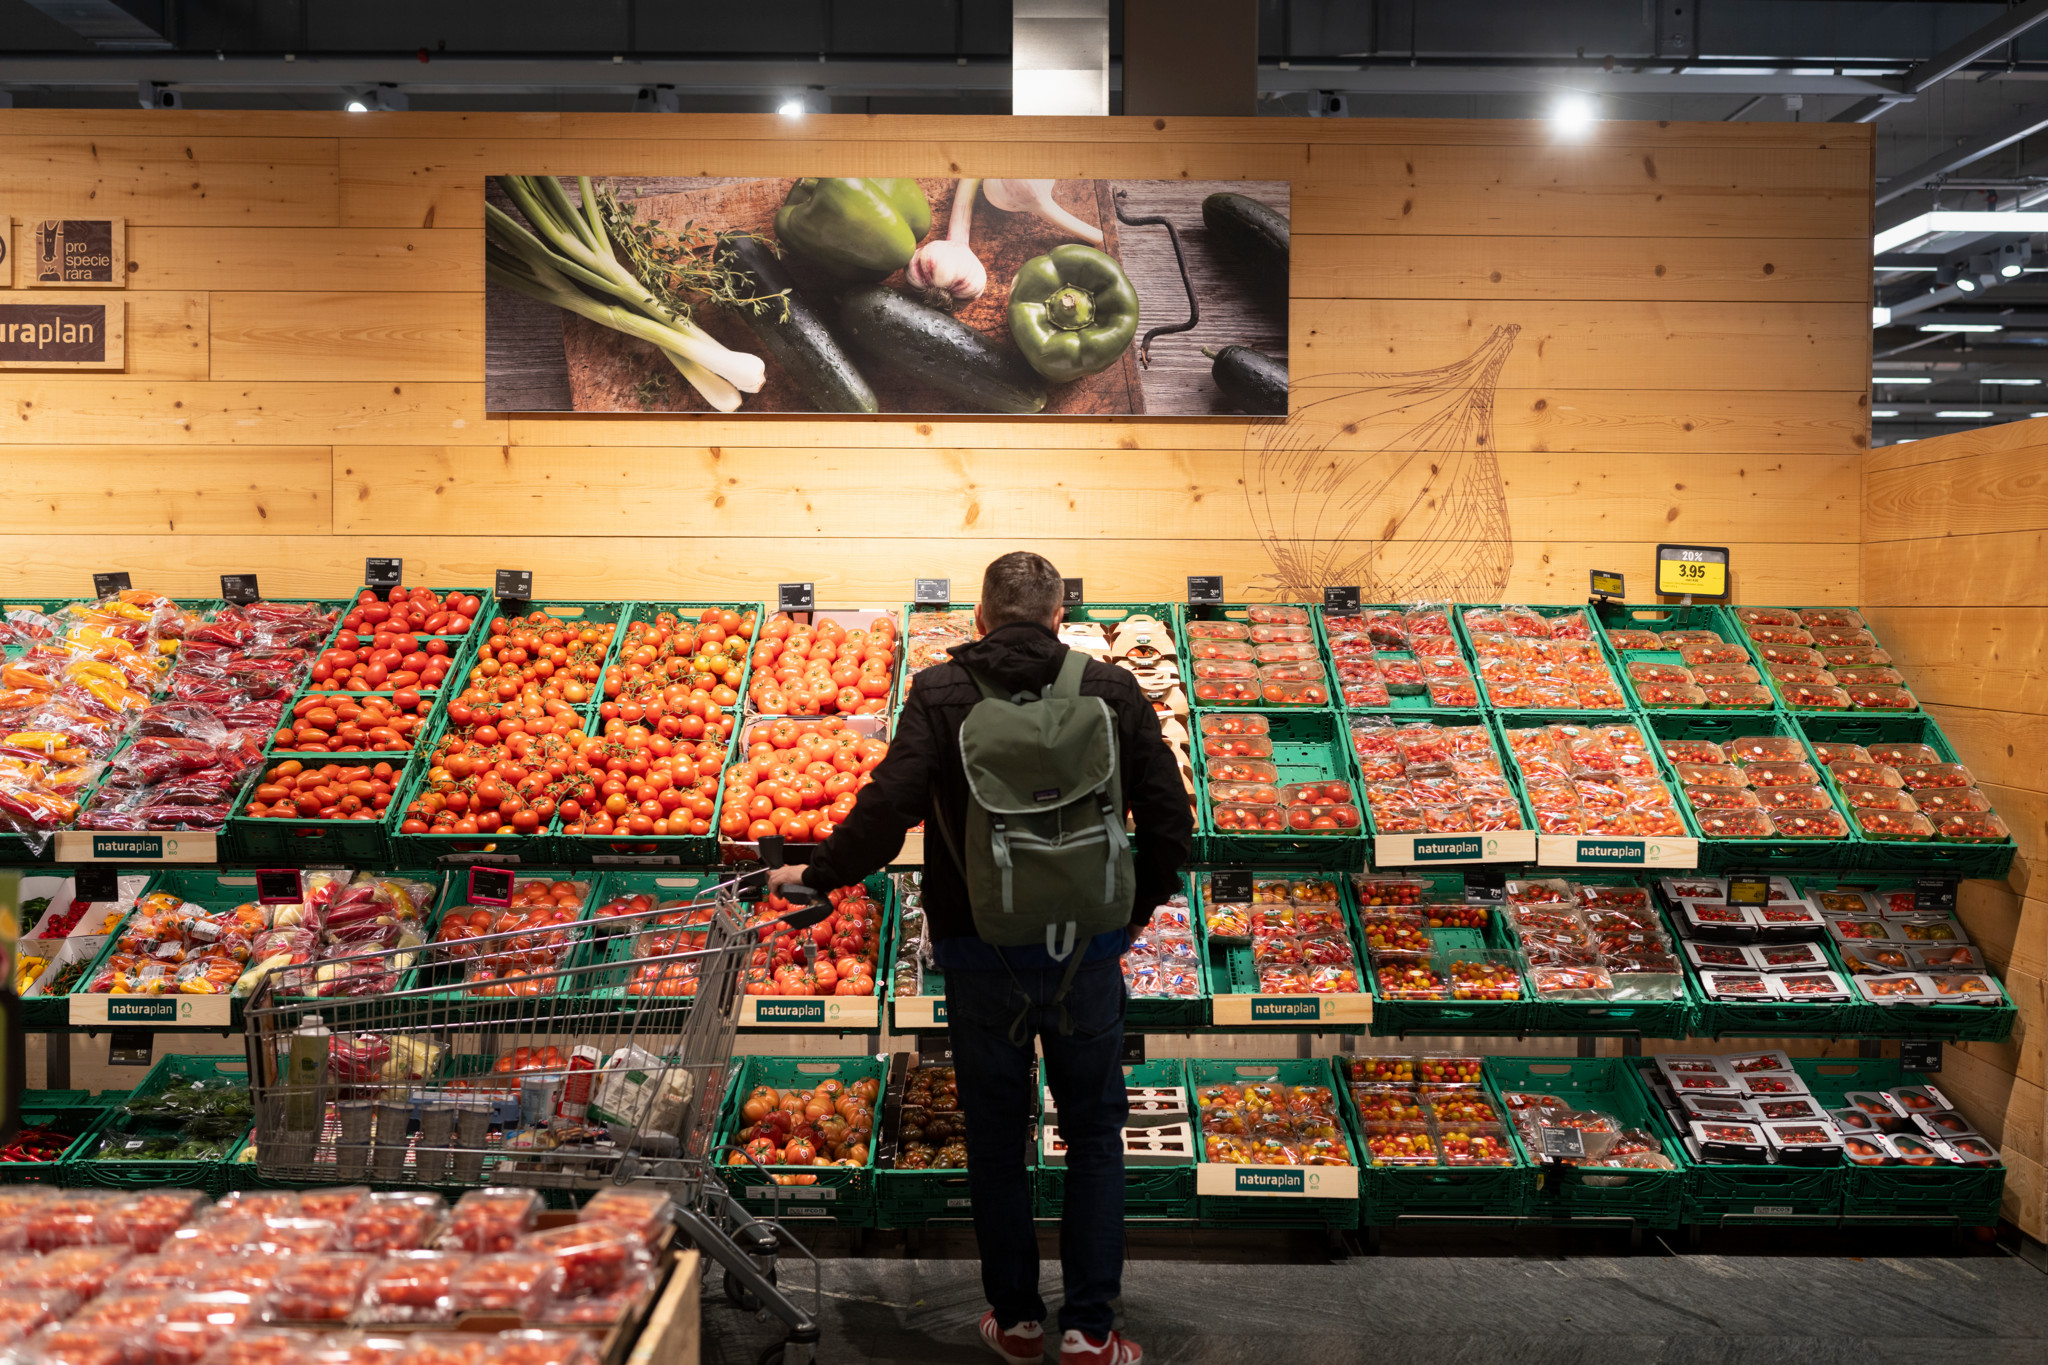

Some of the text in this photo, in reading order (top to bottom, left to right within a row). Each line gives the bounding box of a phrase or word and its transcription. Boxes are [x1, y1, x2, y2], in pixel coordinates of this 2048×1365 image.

[65, 241, 87, 255] pro
[65, 253, 110, 268] specie
[65, 269, 92, 280] rara
[1682, 551, 1703, 562] 20%
[1679, 564, 1706, 578] 3.95
[97, 840, 159, 854] naturaplan
[1418, 841, 1479, 855] naturaplan
[1580, 845, 1642, 859] naturaplan
[112, 1003, 173, 1017] naturaplan
[760, 1004, 821, 1018] naturaplan
[1255, 1002, 1316, 1016] naturaplan
[1239, 1174, 1301, 1188] naturaplan
